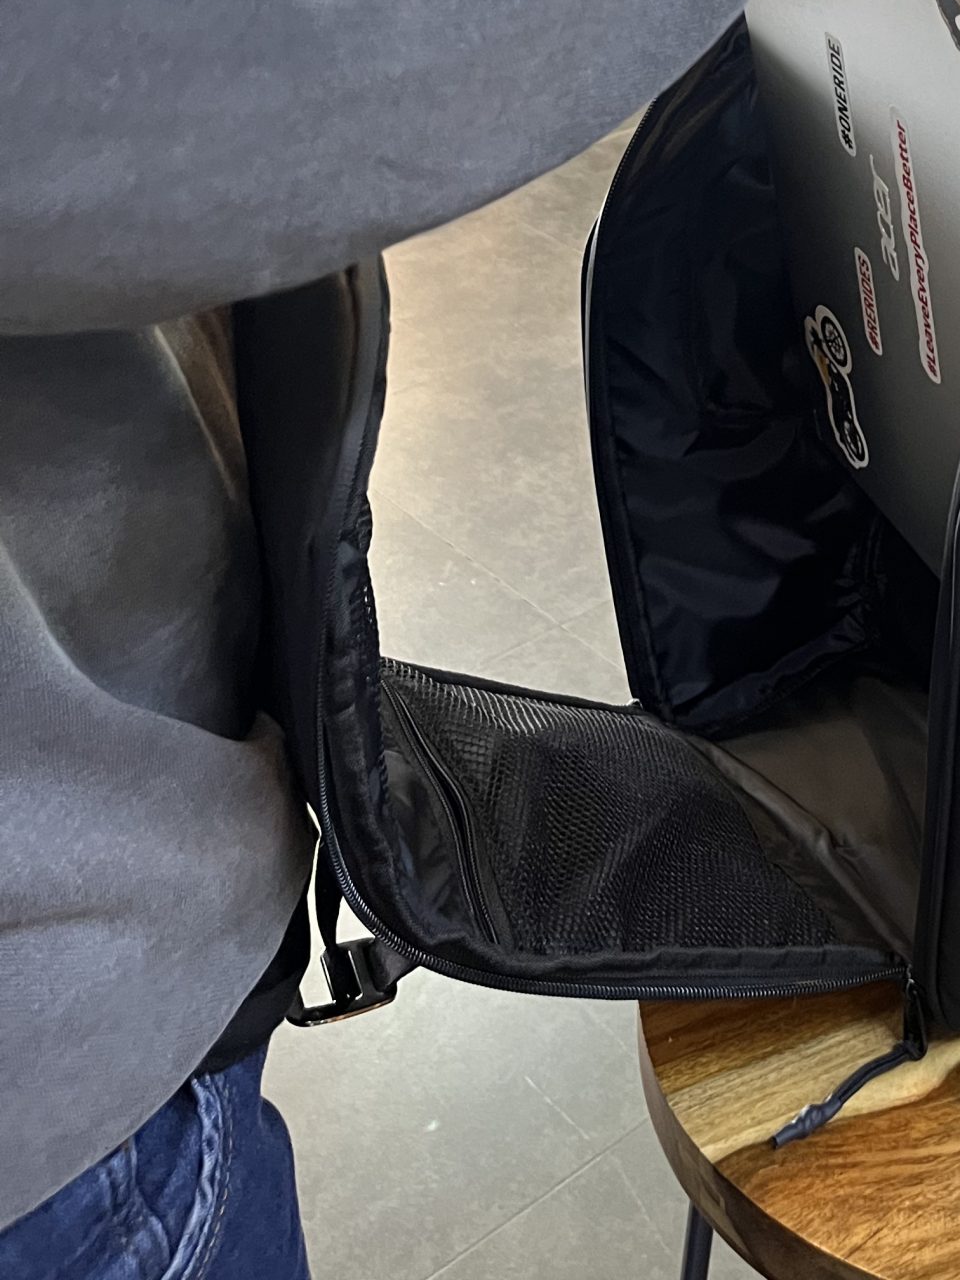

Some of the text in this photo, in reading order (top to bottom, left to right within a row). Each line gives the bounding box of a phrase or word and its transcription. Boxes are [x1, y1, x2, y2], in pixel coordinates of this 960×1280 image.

[827, 38, 854, 150] #ONERIDE
[869, 153, 900, 281] acer
[896, 119, 938, 377] #LeaveEveryPlaceBetter
[857, 254, 880, 351] #RERIDES
